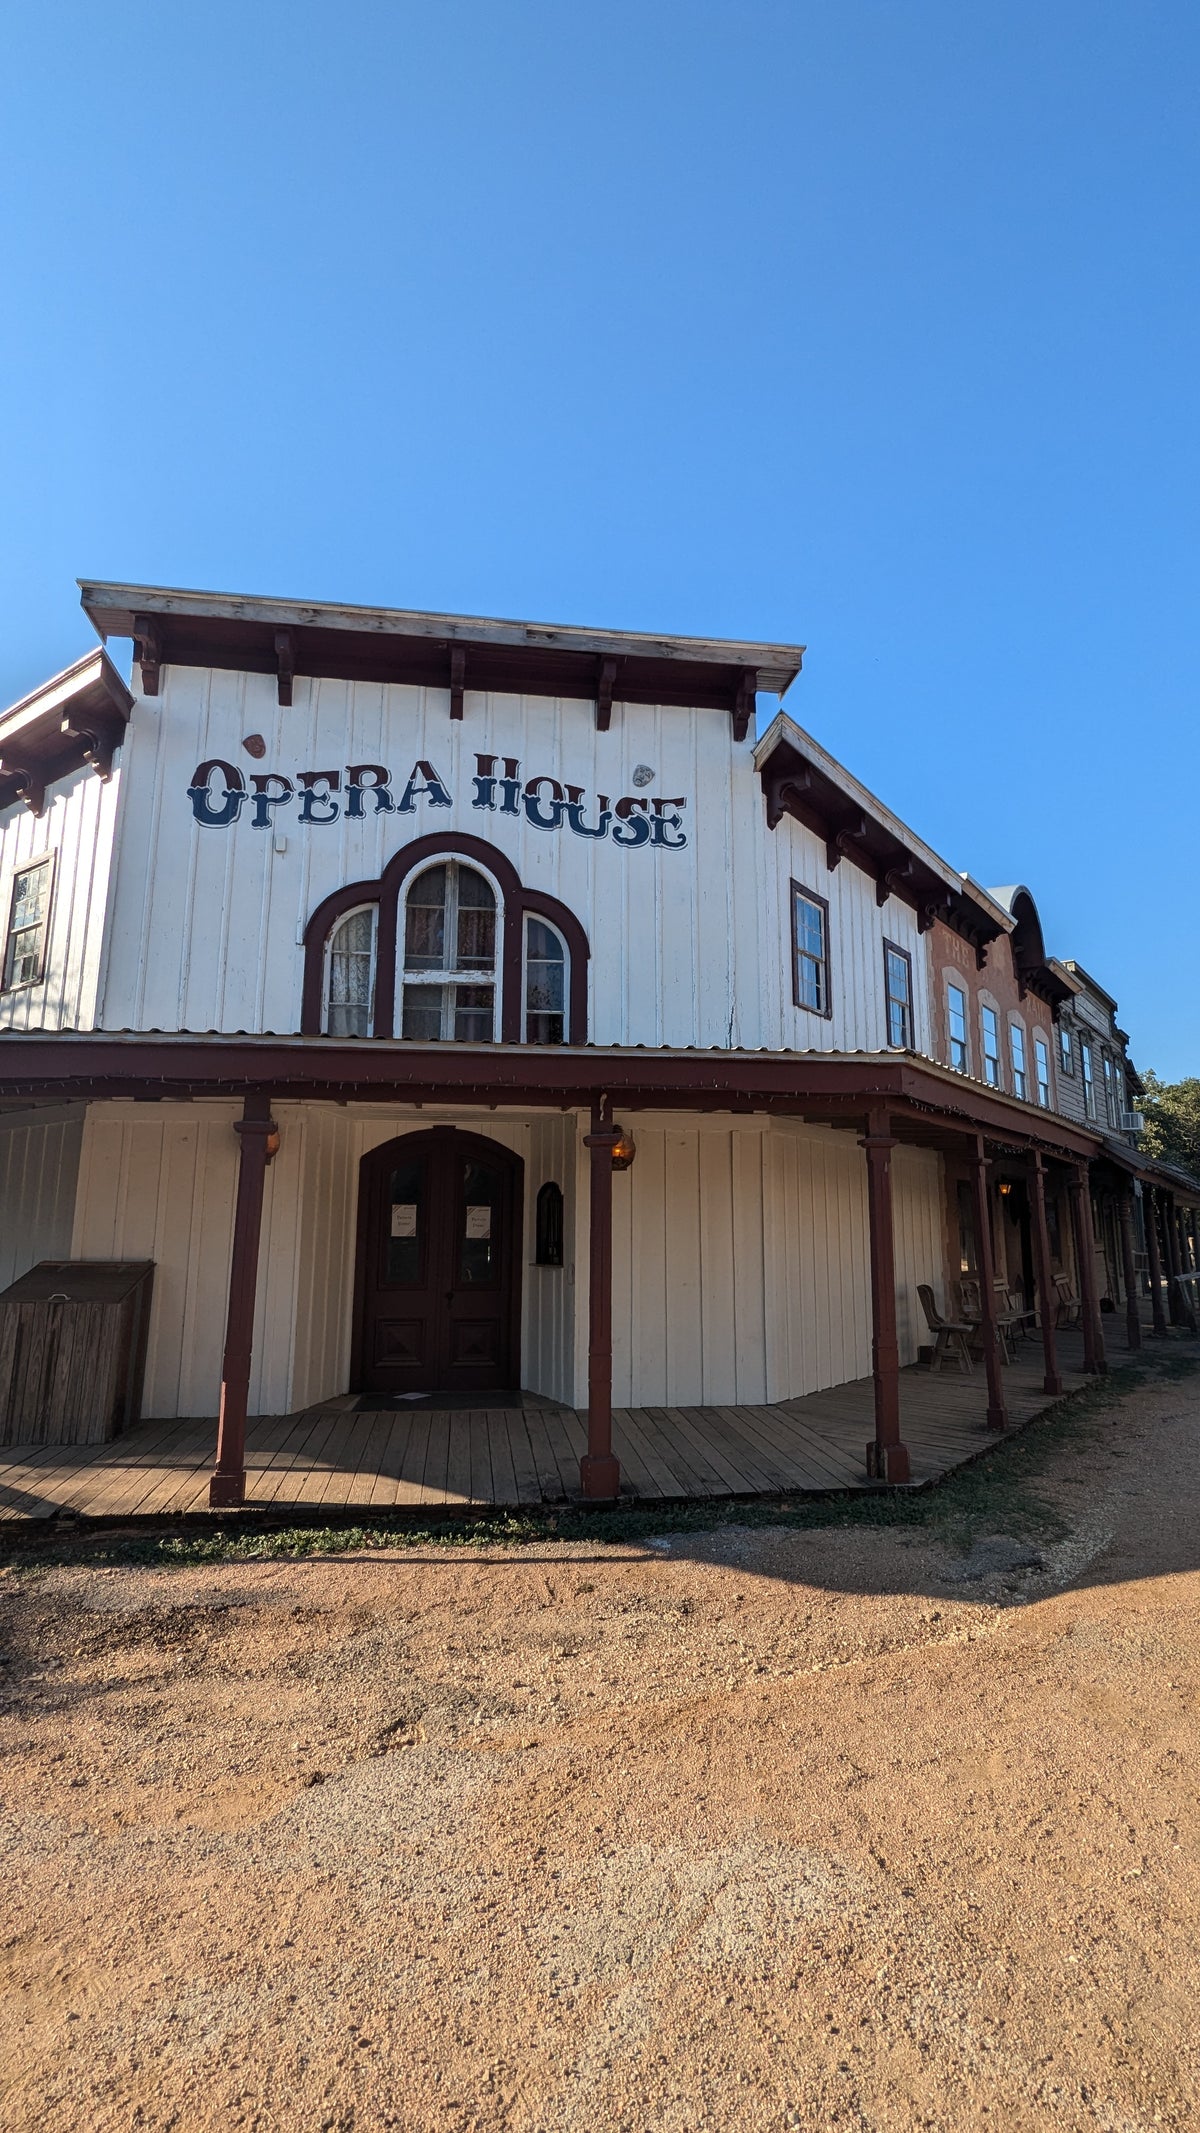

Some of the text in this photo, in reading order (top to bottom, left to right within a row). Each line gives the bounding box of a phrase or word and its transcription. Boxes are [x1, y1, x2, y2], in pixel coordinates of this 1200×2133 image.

[187, 752, 688, 850] OPERA HOUSE
[942, 930, 969, 967] THE
